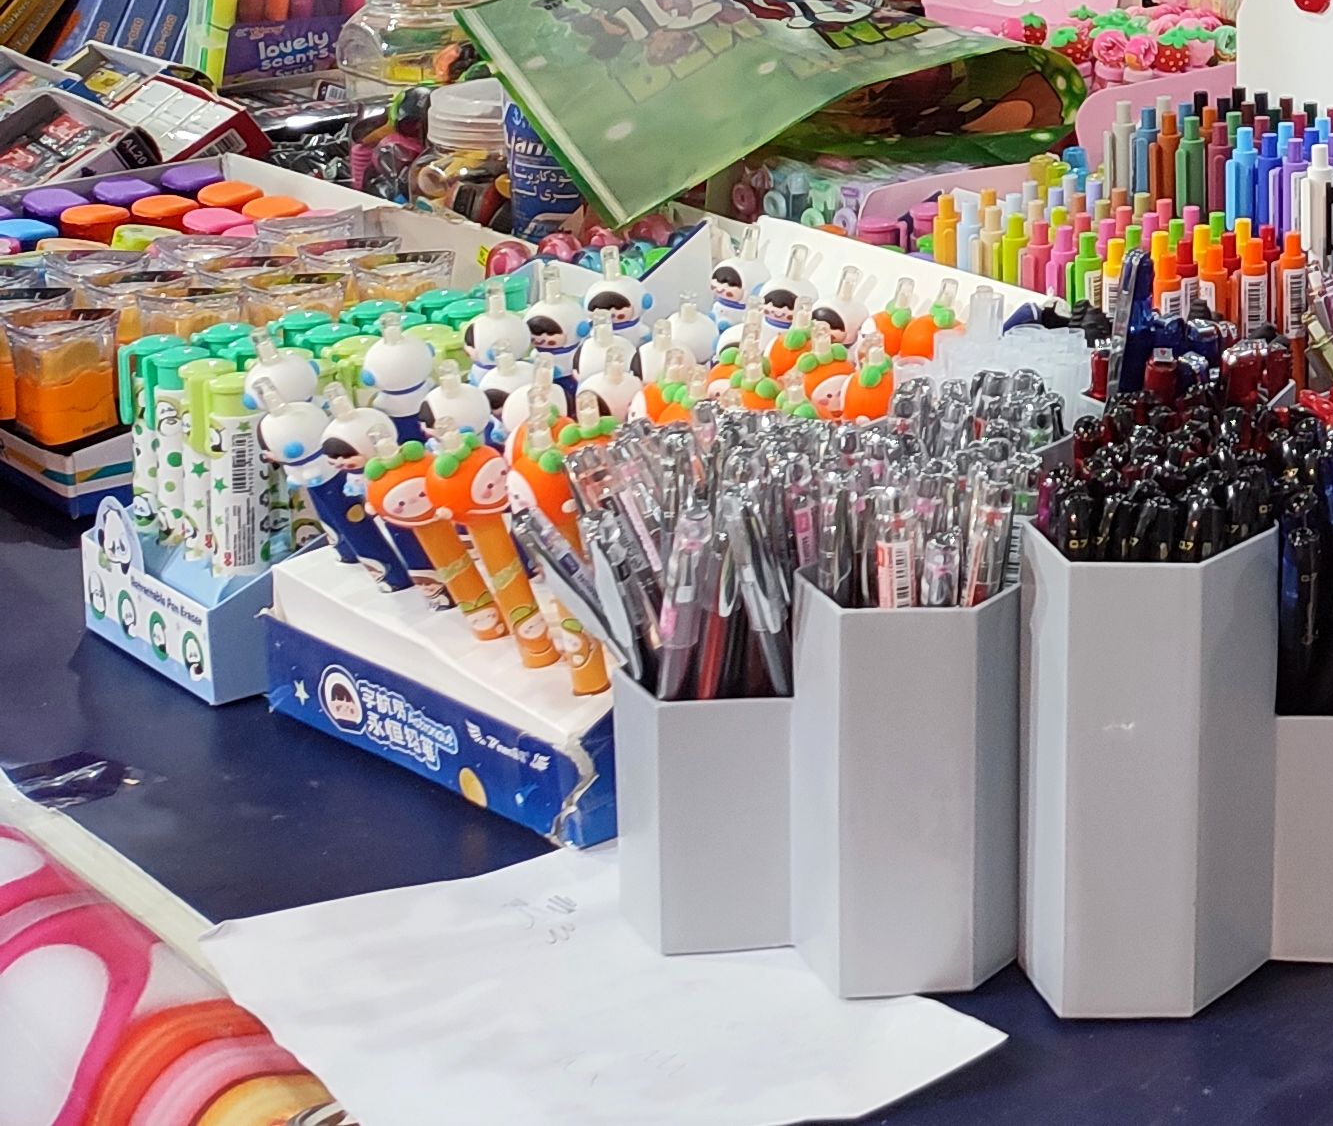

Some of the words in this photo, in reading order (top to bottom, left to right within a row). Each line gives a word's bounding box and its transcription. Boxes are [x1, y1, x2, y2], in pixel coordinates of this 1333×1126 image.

[258, 31, 330, 60] lovely
[261, 47, 329, 70] scents
[122, 137, 149, 166] AL20
